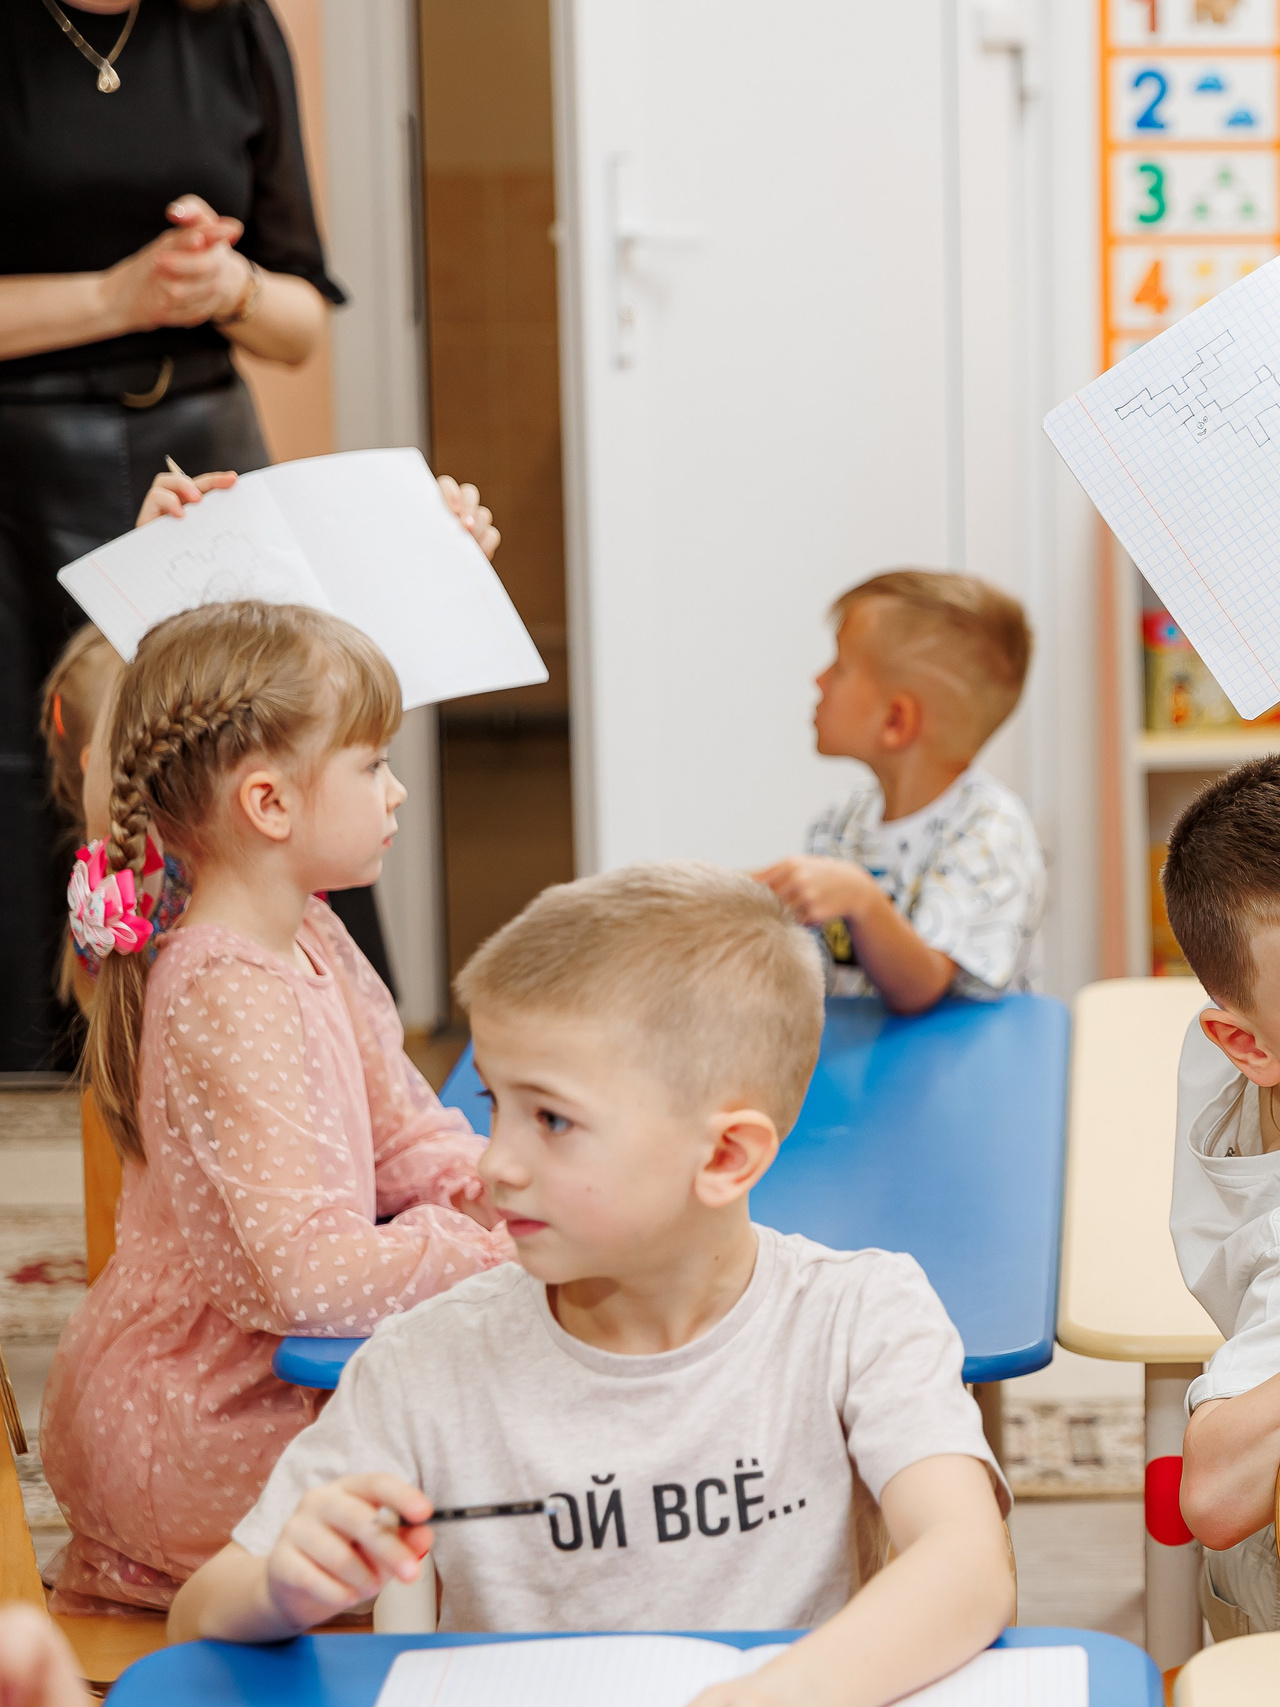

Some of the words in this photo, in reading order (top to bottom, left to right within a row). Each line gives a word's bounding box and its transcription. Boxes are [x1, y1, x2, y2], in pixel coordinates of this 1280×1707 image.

[1133, 70, 1168, 130] 2
[1138, 162, 1166, 224] 3
[1133, 259, 1170, 315] 4
[547, 1472, 628, 1552] ОЙ
[652, 1457, 807, 1543] ВСЁ...
